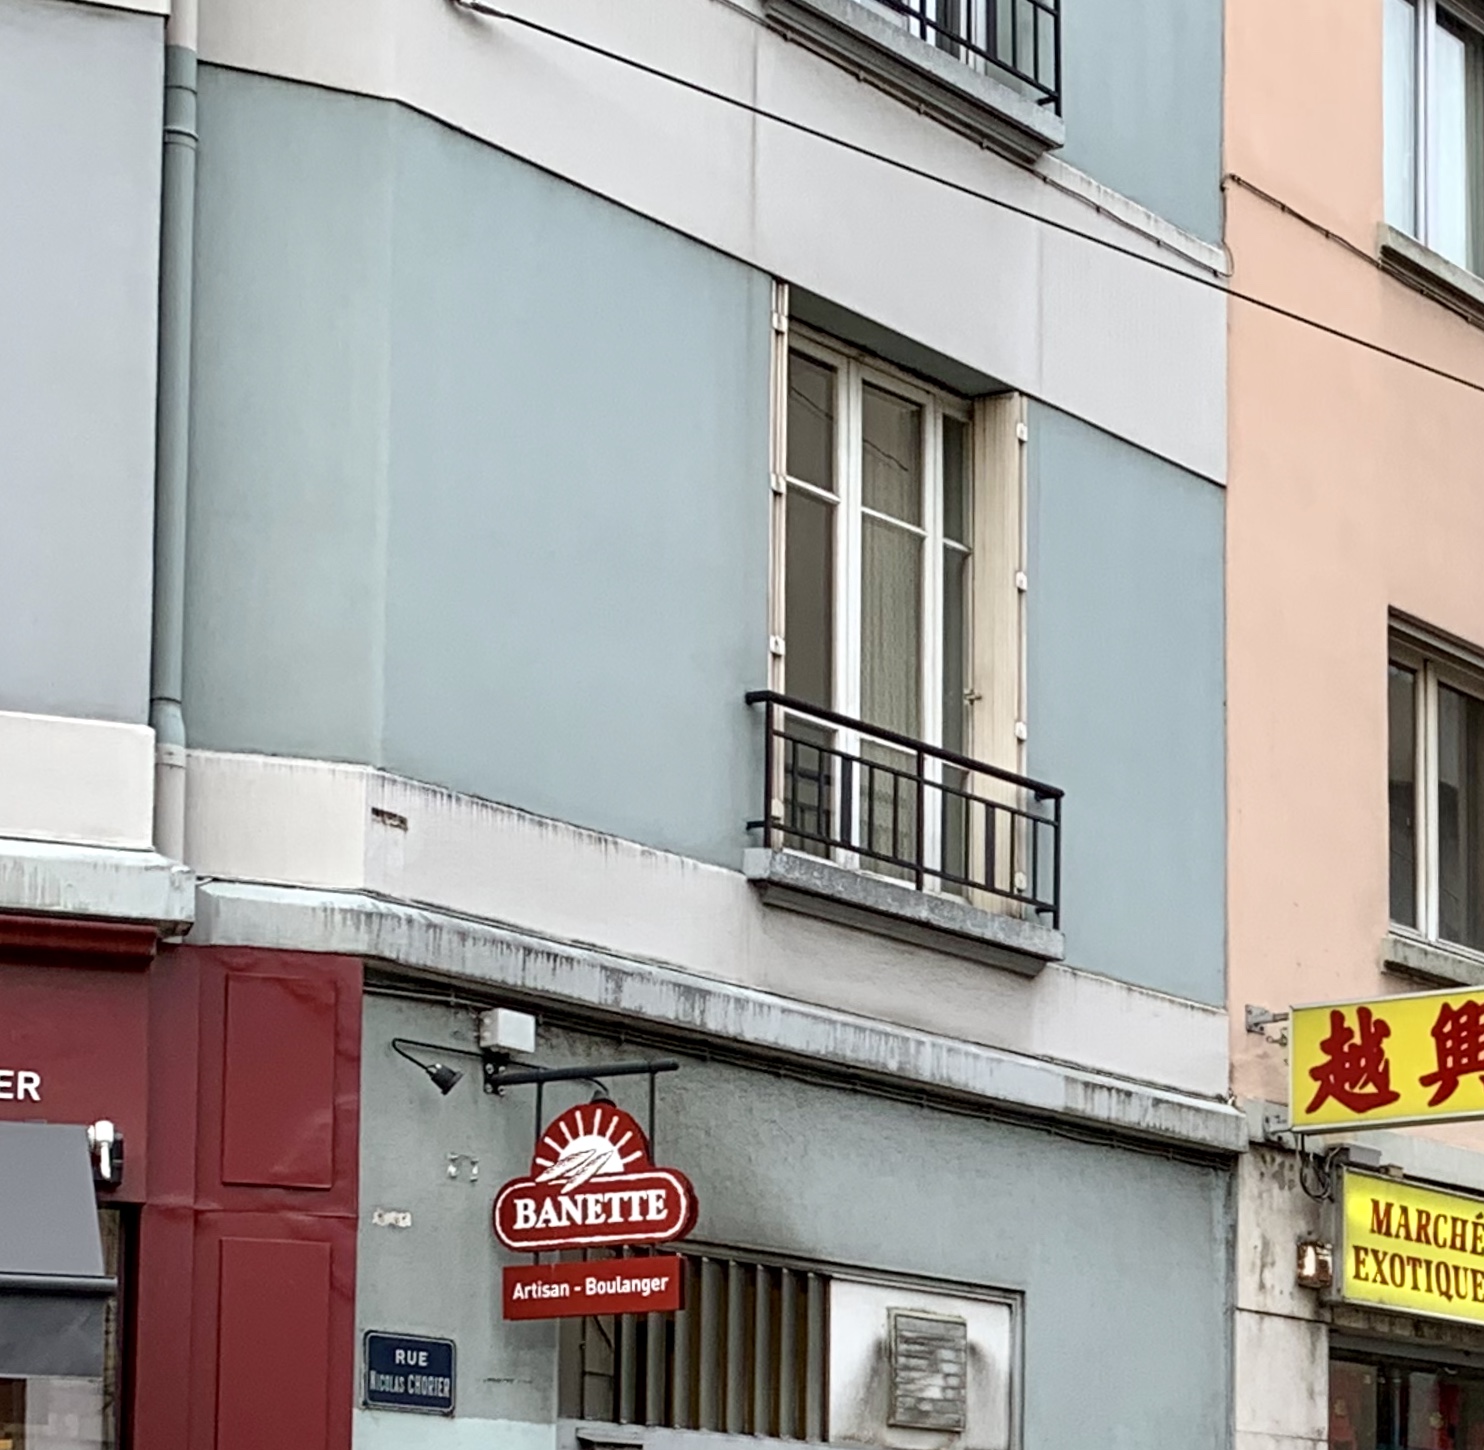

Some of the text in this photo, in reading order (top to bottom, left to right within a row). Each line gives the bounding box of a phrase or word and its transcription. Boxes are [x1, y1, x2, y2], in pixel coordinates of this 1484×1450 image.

[0, 1069, 41, 1101] ER
[513, 1189, 669, 1230] BANETTE
[512, 1280, 570, 1300] Artisan
[585, 1275, 669, 1297] Boulanger
[395, 1349, 429, 1367] RUE
